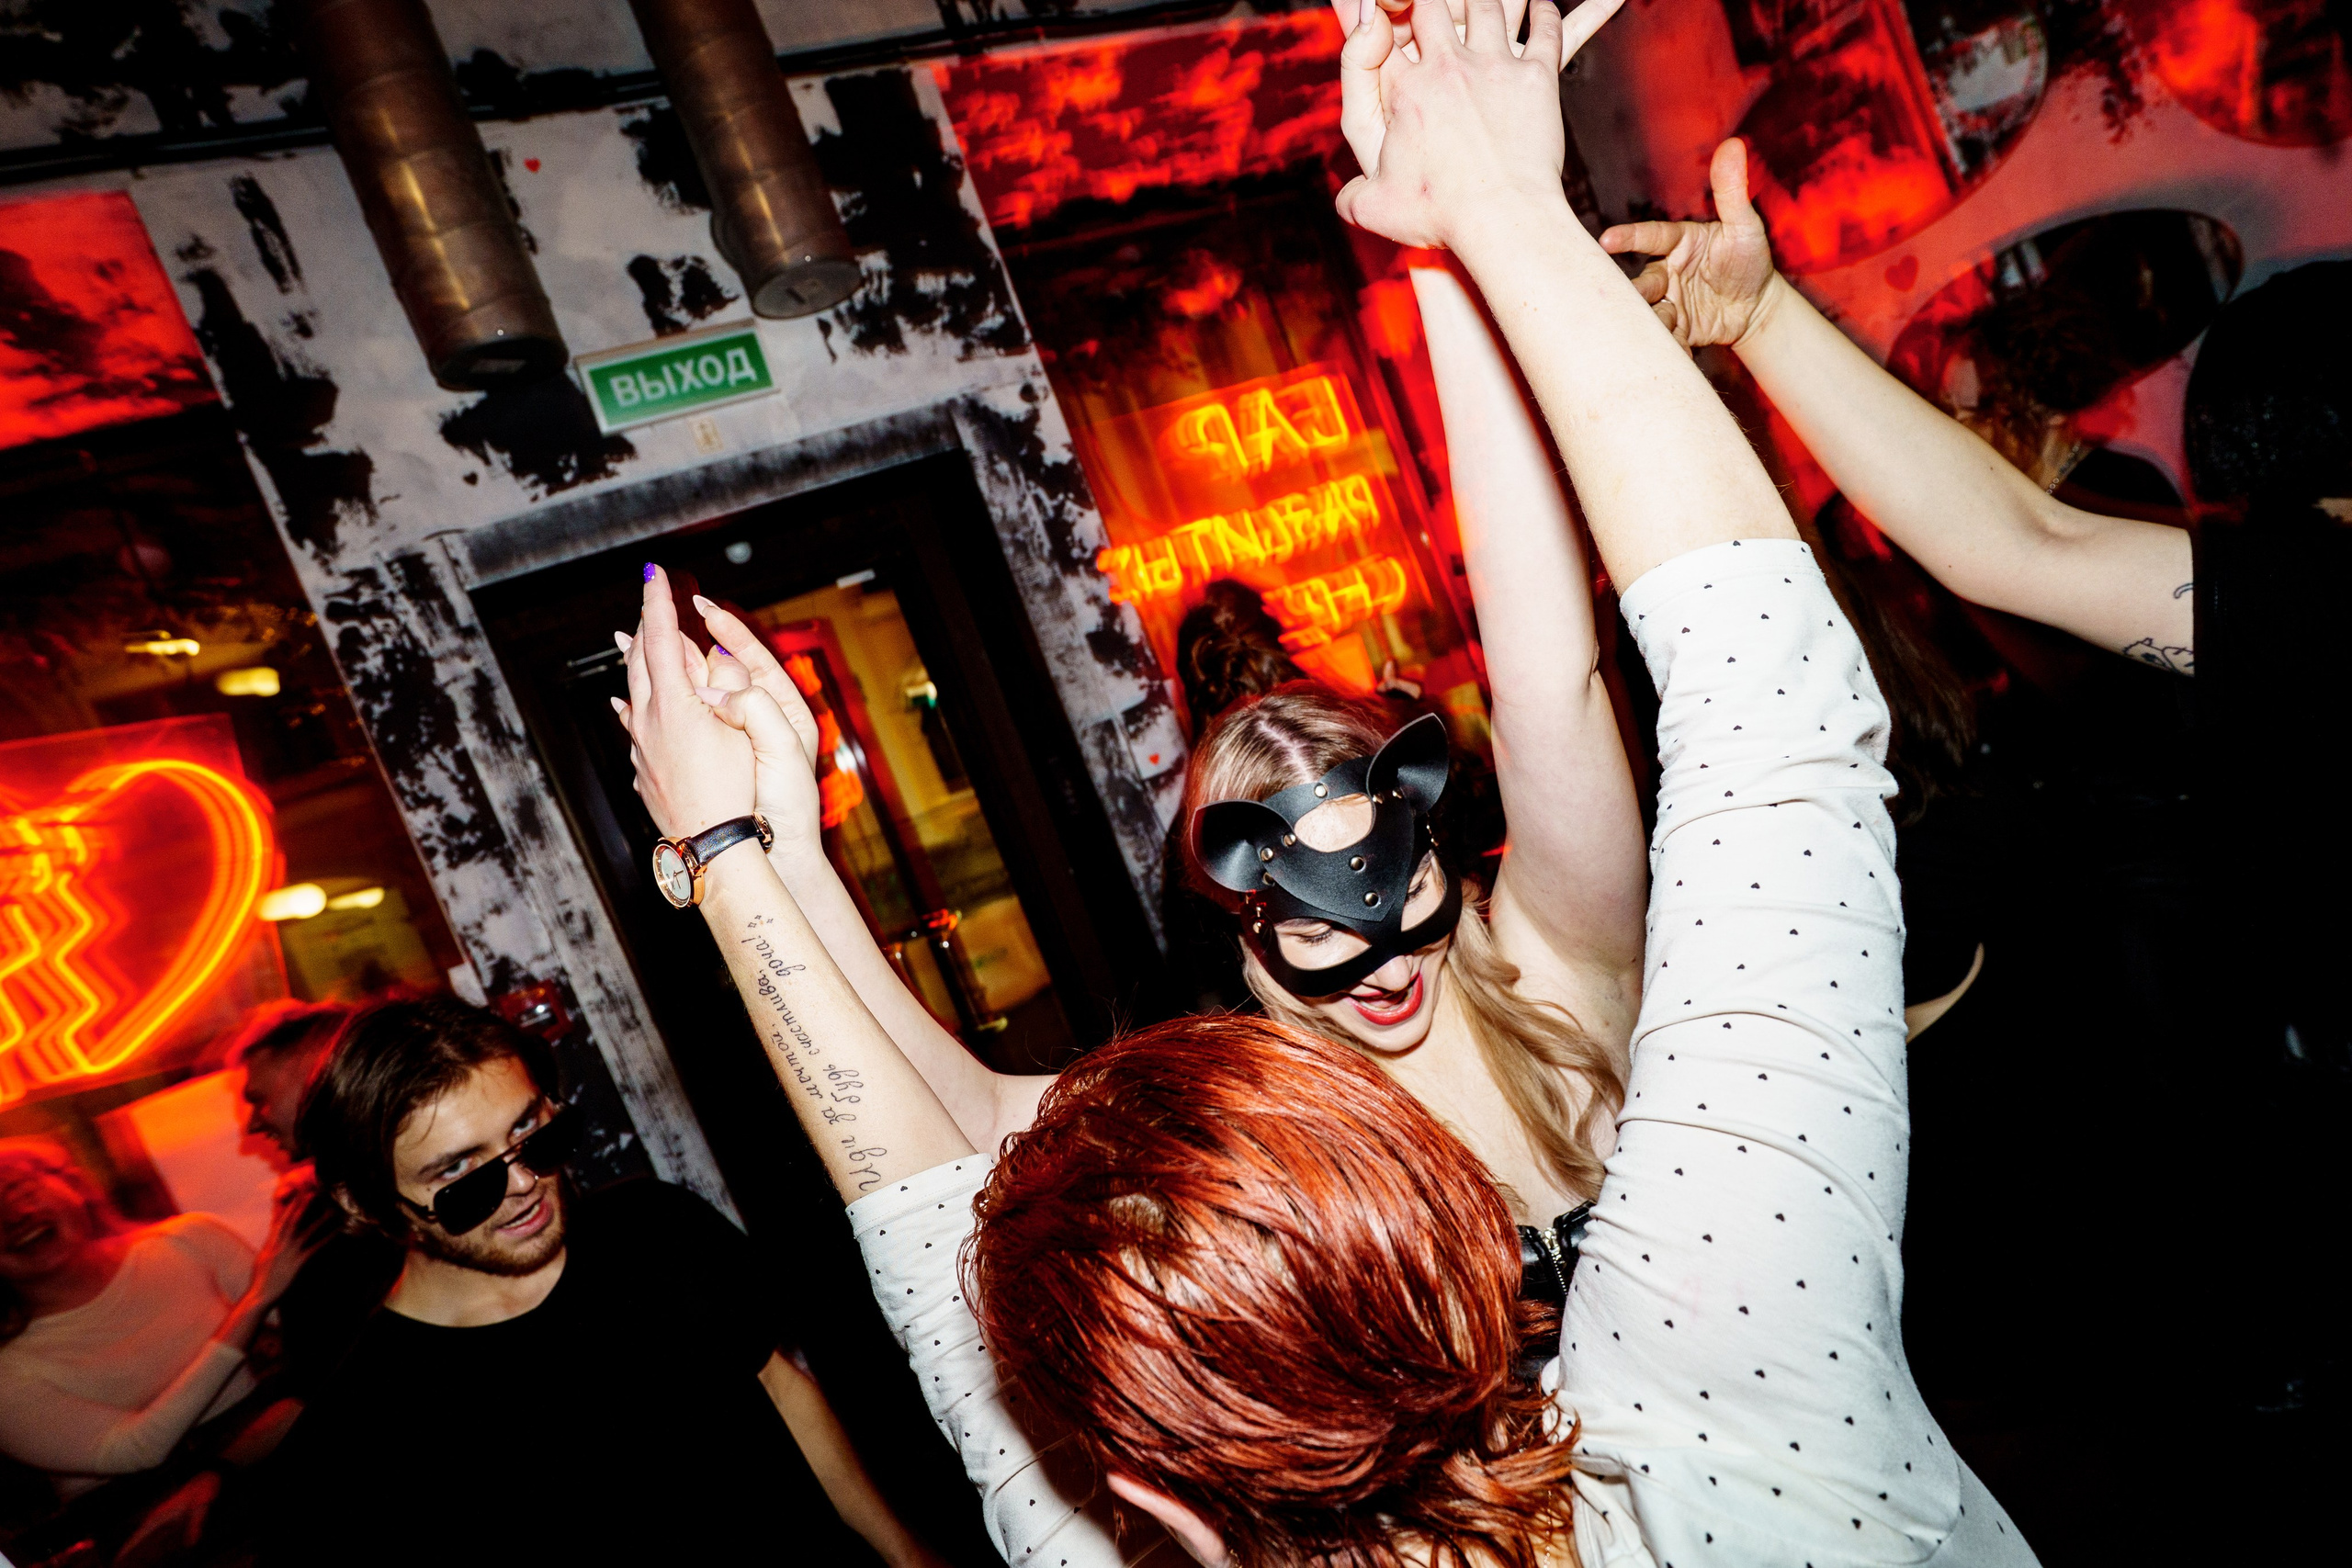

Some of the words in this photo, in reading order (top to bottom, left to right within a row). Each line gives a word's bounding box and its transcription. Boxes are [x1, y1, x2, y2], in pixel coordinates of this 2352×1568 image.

[609, 346, 758, 407] ВЫХОД
[741, 934, 806, 976] доча!
[821, 1106, 856, 1125] за
[841, 1134, 888, 1191] Иди
